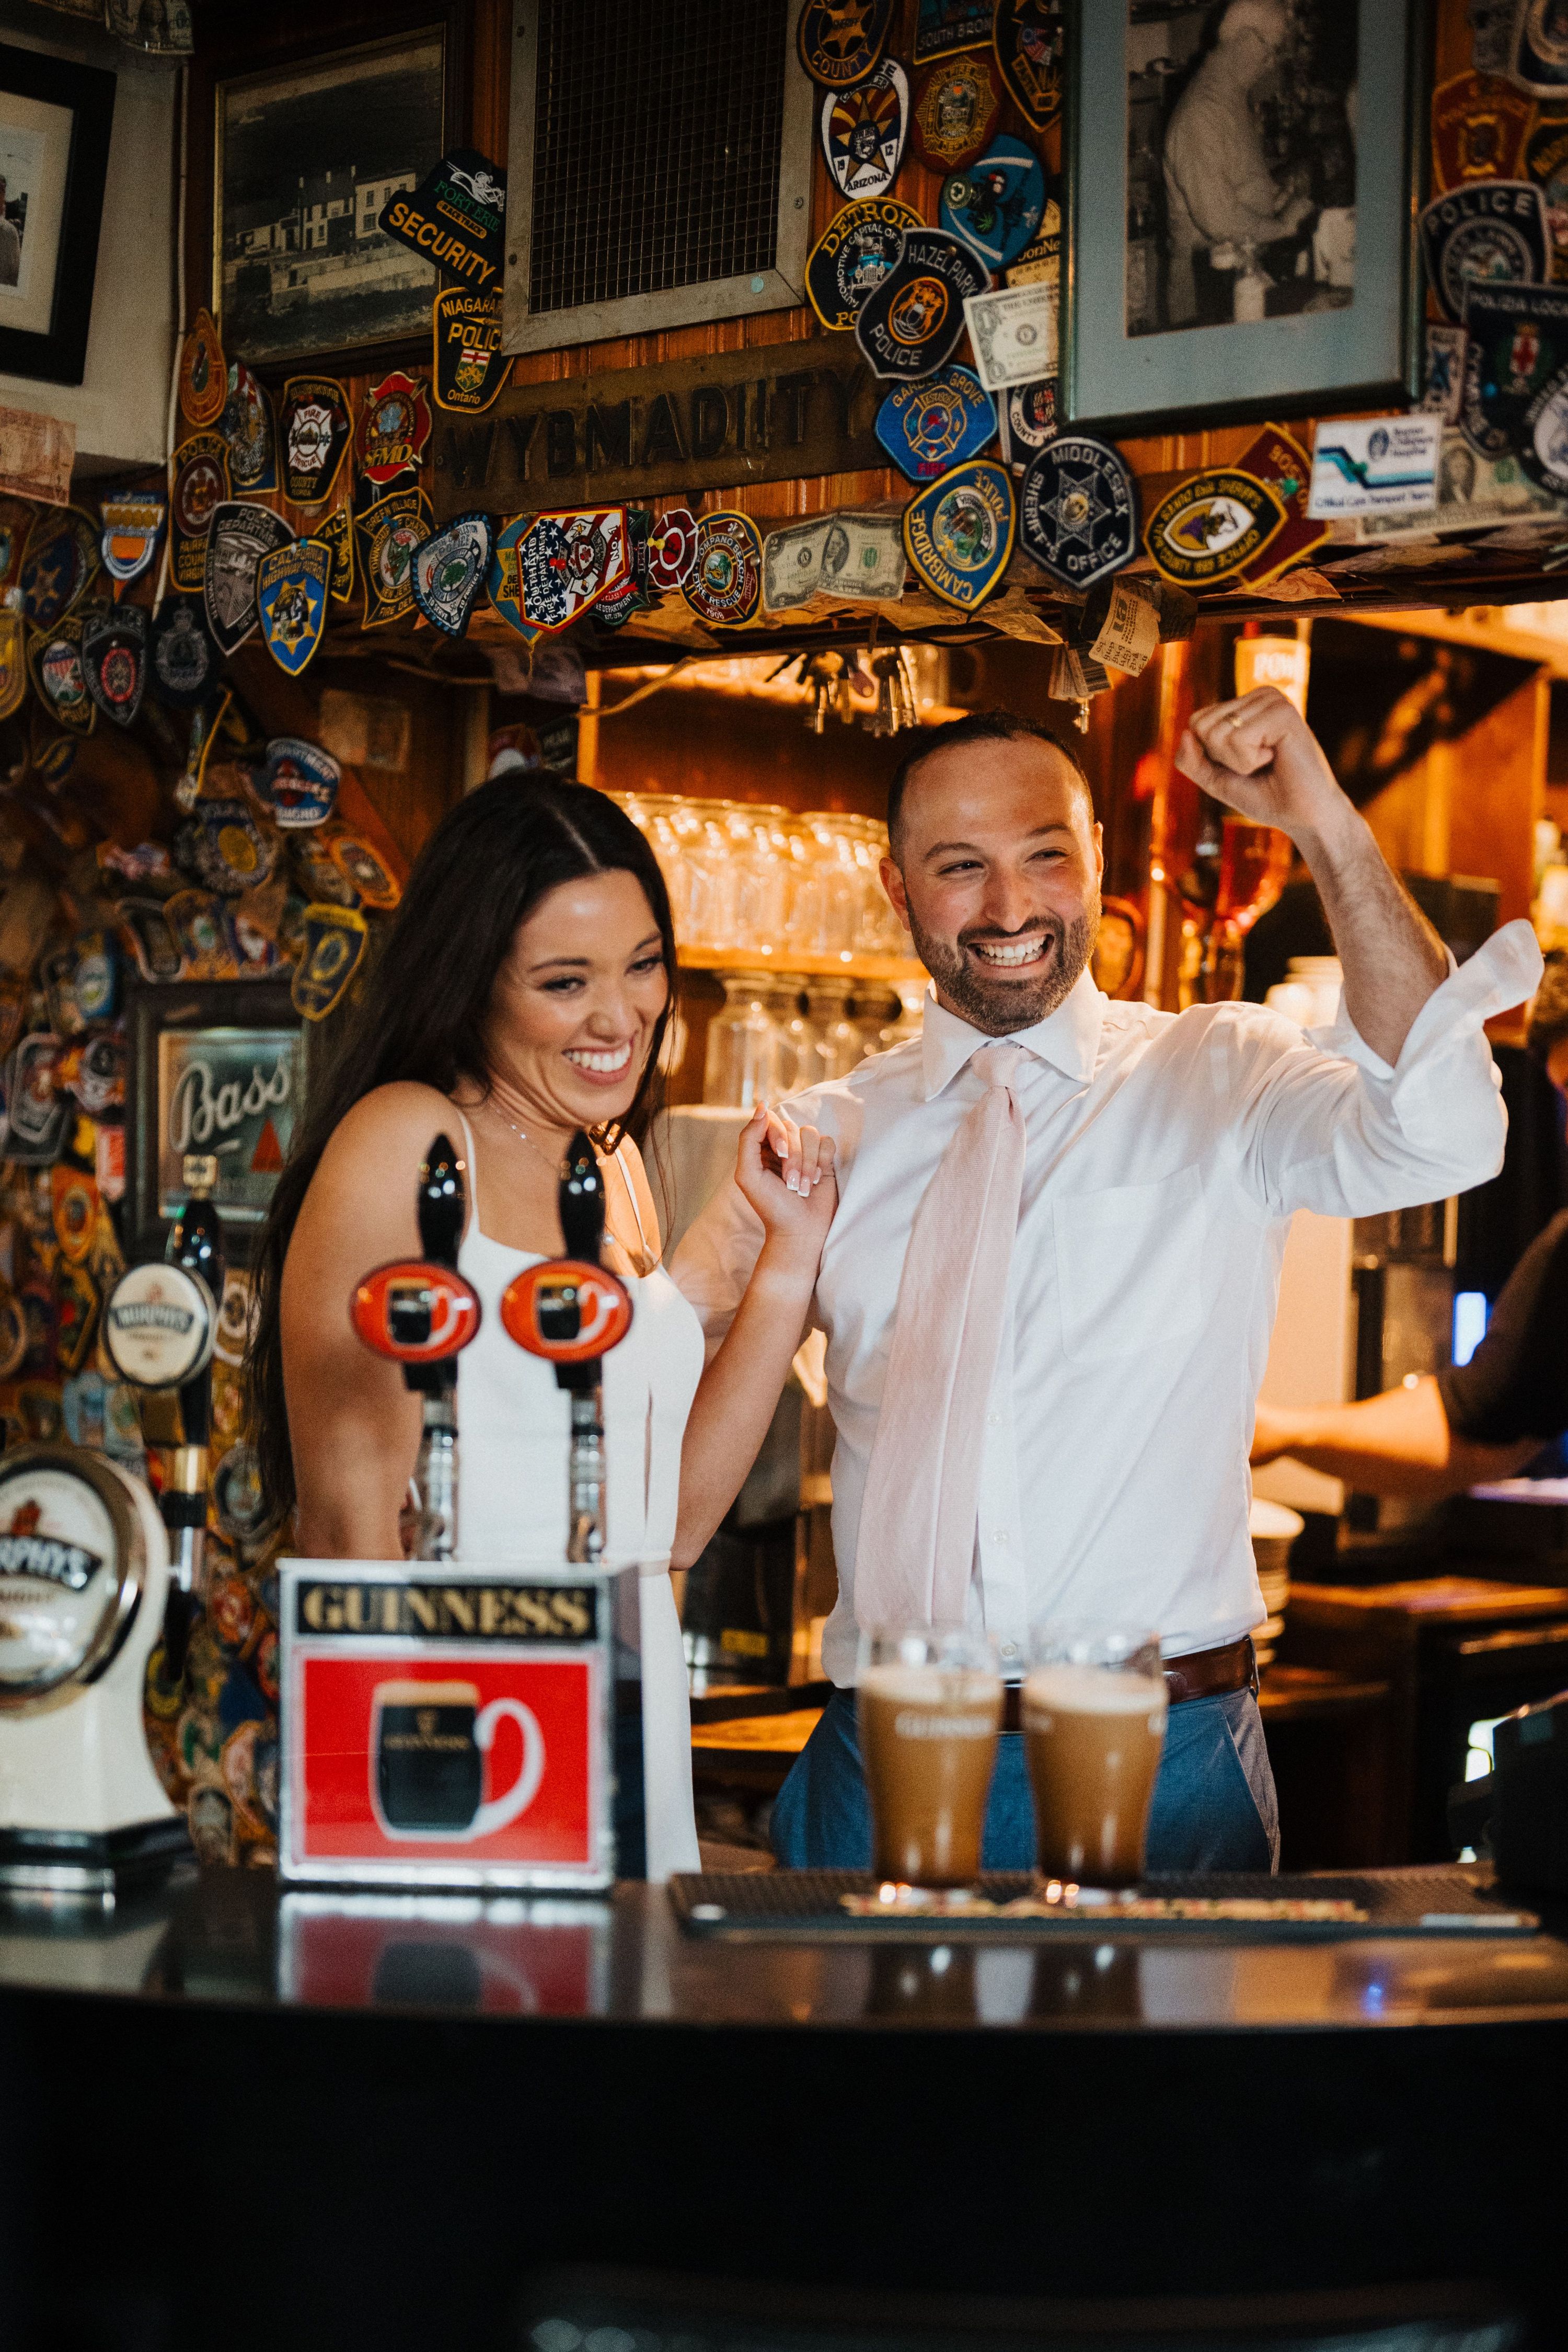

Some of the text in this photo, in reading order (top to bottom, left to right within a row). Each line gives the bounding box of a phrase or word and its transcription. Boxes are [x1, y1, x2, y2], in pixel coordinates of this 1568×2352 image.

[917, 16, 993, 51] SOUTH BRON
[837, 158, 846, 171] 19
[885, 144, 894, 156] 12
[847, 172, 887, 192] ARIZONA
[434, 180, 500, 232] FORT ERIE
[440, 202, 484, 235] RACETRACK
[1426, 190, 1534, 236] POLICE
[389, 202, 497, 285] SECURITY
[837, 244, 858, 307] AUTOMOTIVE
[848, 224, 883, 246] CAPITAL
[884, 229, 898, 242] OF
[908, 244, 979, 298] HAZEL PARK
[440, 296, 497, 318] NIAGARA
[447, 321, 502, 351] POLIC
[869, 322, 923, 366] POLICE
[447, 388, 480, 405] Ontario
[949, 372, 986, 408] GROVE
[304, 409, 321, 420] FIRE
[1012, 411, 1037, 445] COUNTY
[974, 468, 1010, 522] POLICE
[1051, 444, 1130, 519] MIDDLESEX
[366, 498, 418, 532] GREEN VILLAGE
[1024, 470, 1061, 563] SHERIFF'S
[268, 546, 326, 571] CALIFORNIA
[371, 525, 391, 576] TOWNSHIP
[404, 517, 429, 541] CHATH
[439, 535, 470, 556] POLICE
[607, 525, 620, 562] NO. 1
[696, 535, 745, 581] POMPANO BEACH
[911, 509, 974, 602] CAMBRIDGE
[1066, 532, 1123, 573] OFFICE
[261, 560, 326, 591] HIGHWAY PATROL
[527, 536, 546, 615] SOUTHARD
[538, 525, 559, 620] FIRE DEPARTMENT
[693, 572, 742, 608] FIRE RESCUE
[378, 606, 396, 617] FIRE
[433, 601, 450, 621] SERVE
[602, 593, 634, 614] DEPARTMENT
[605, 592, 620, 602] CLASS
[705, 607, 725, 620] 1908
[169, 1055, 292, 1152] Bass
[303, 1584, 592, 1637] GUINNESS
